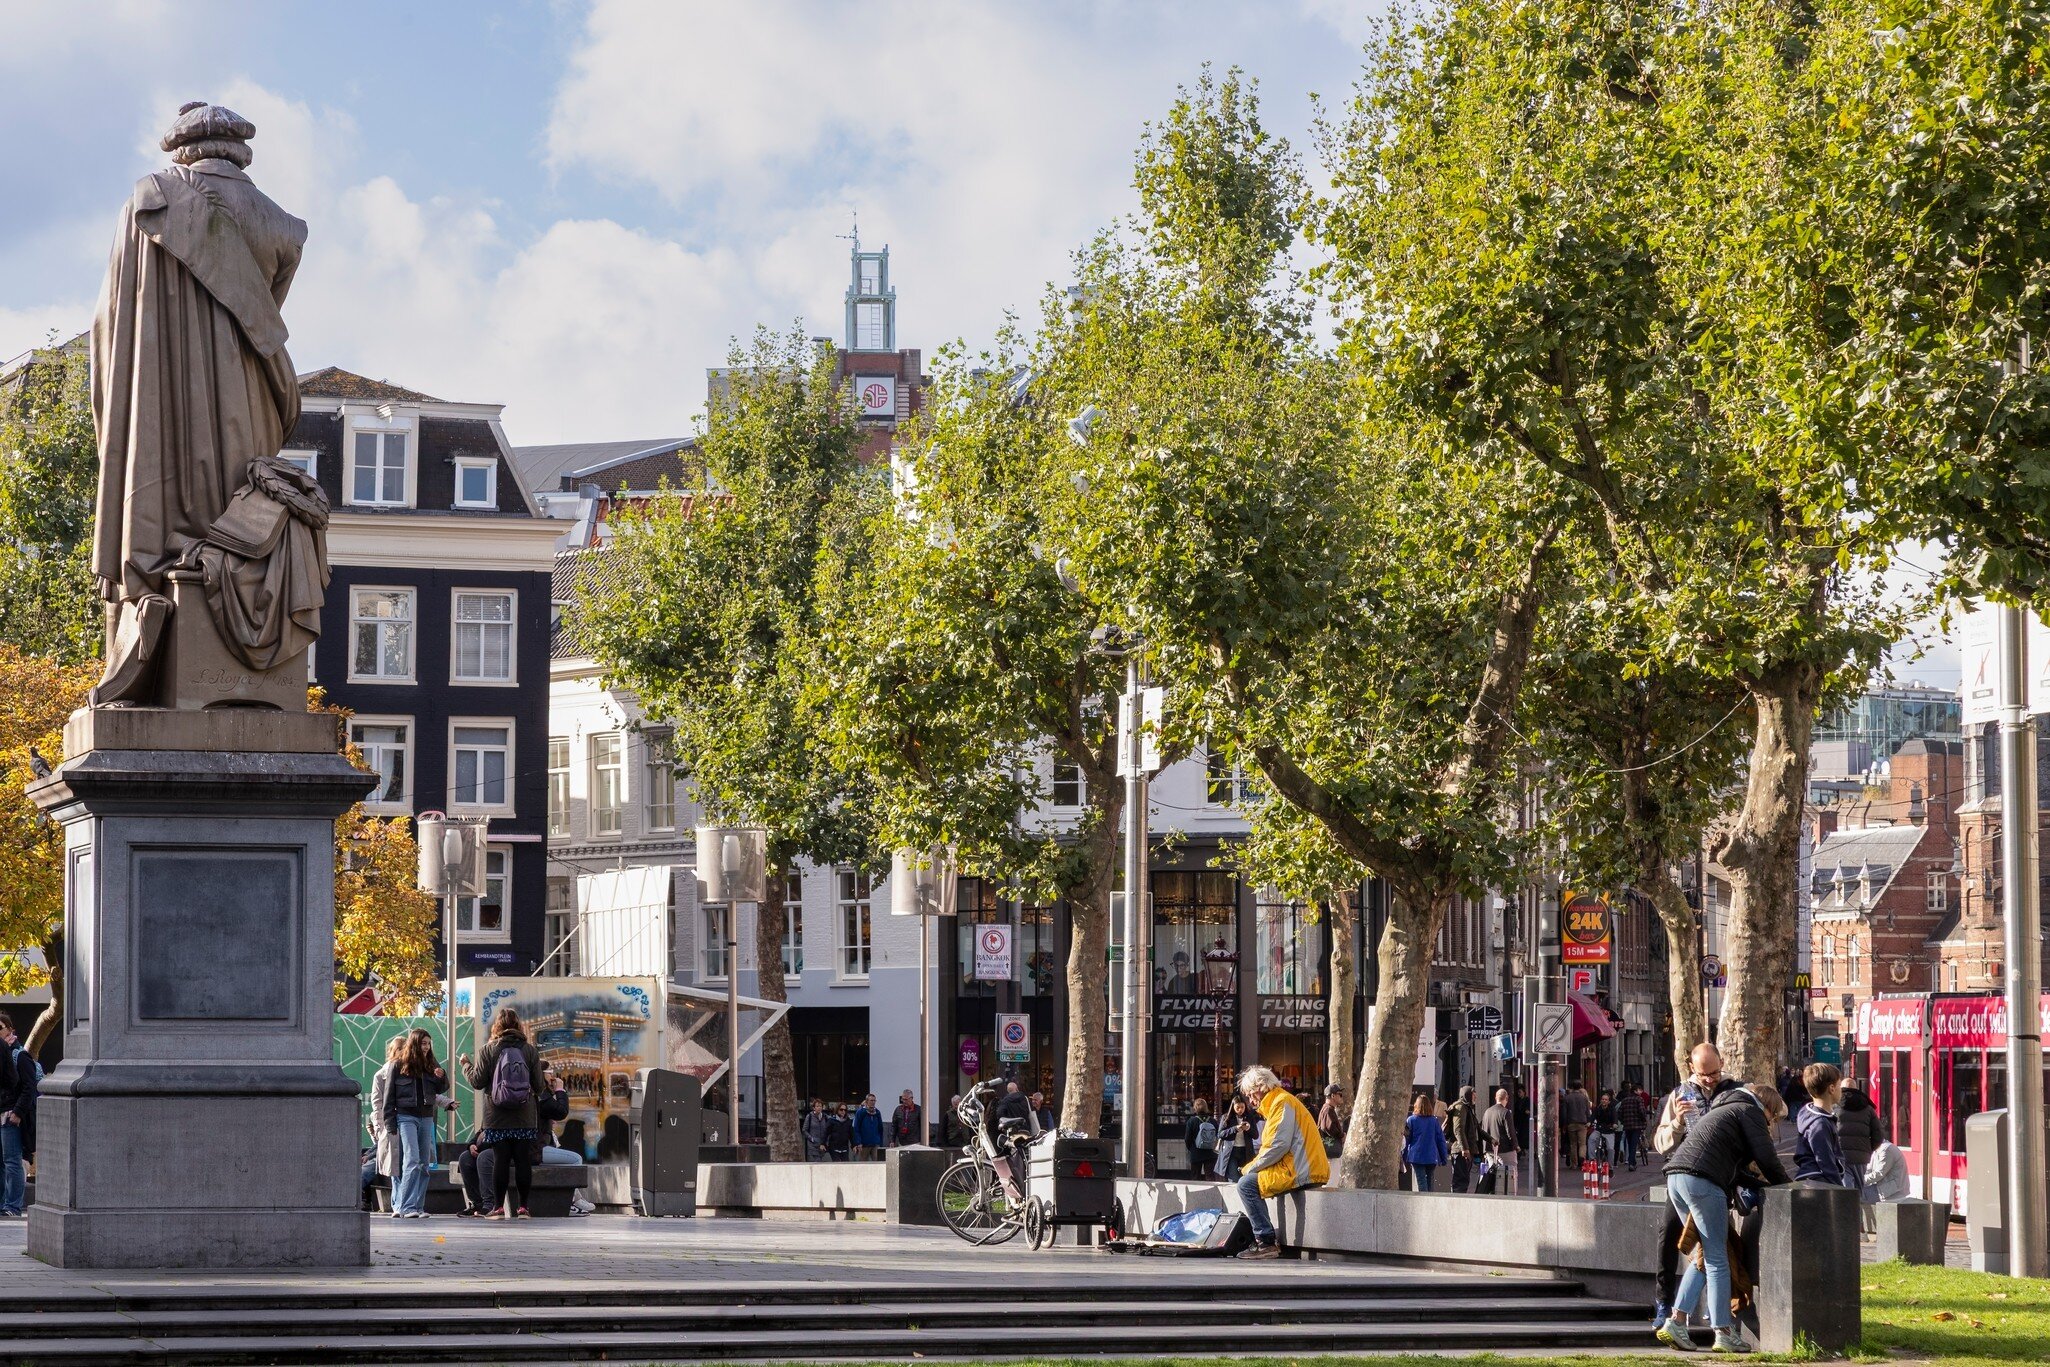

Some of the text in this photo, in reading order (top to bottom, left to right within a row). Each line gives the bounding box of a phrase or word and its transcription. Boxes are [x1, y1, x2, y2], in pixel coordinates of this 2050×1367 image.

[1570, 912, 1603, 930] 24K
[1579, 930, 1596, 940] bar
[1567, 947, 1585, 956] 15M
[1160, 998, 1234, 1011] FLYING
[1262, 998, 1326, 1011] FLYING
[1158, 1014, 1234, 1028] TIGER
[1260, 1014, 1326, 1028] TIGER
[1871, 1008, 1895, 1041] Simply
[1896, 1008, 1920, 1035] check
[1937, 1008, 1946, 1035] in
[1948, 1007, 1969, 1035] and
[1971, 1006, 1988, 1034] out
[962, 1051, 978, 1062] 30%
